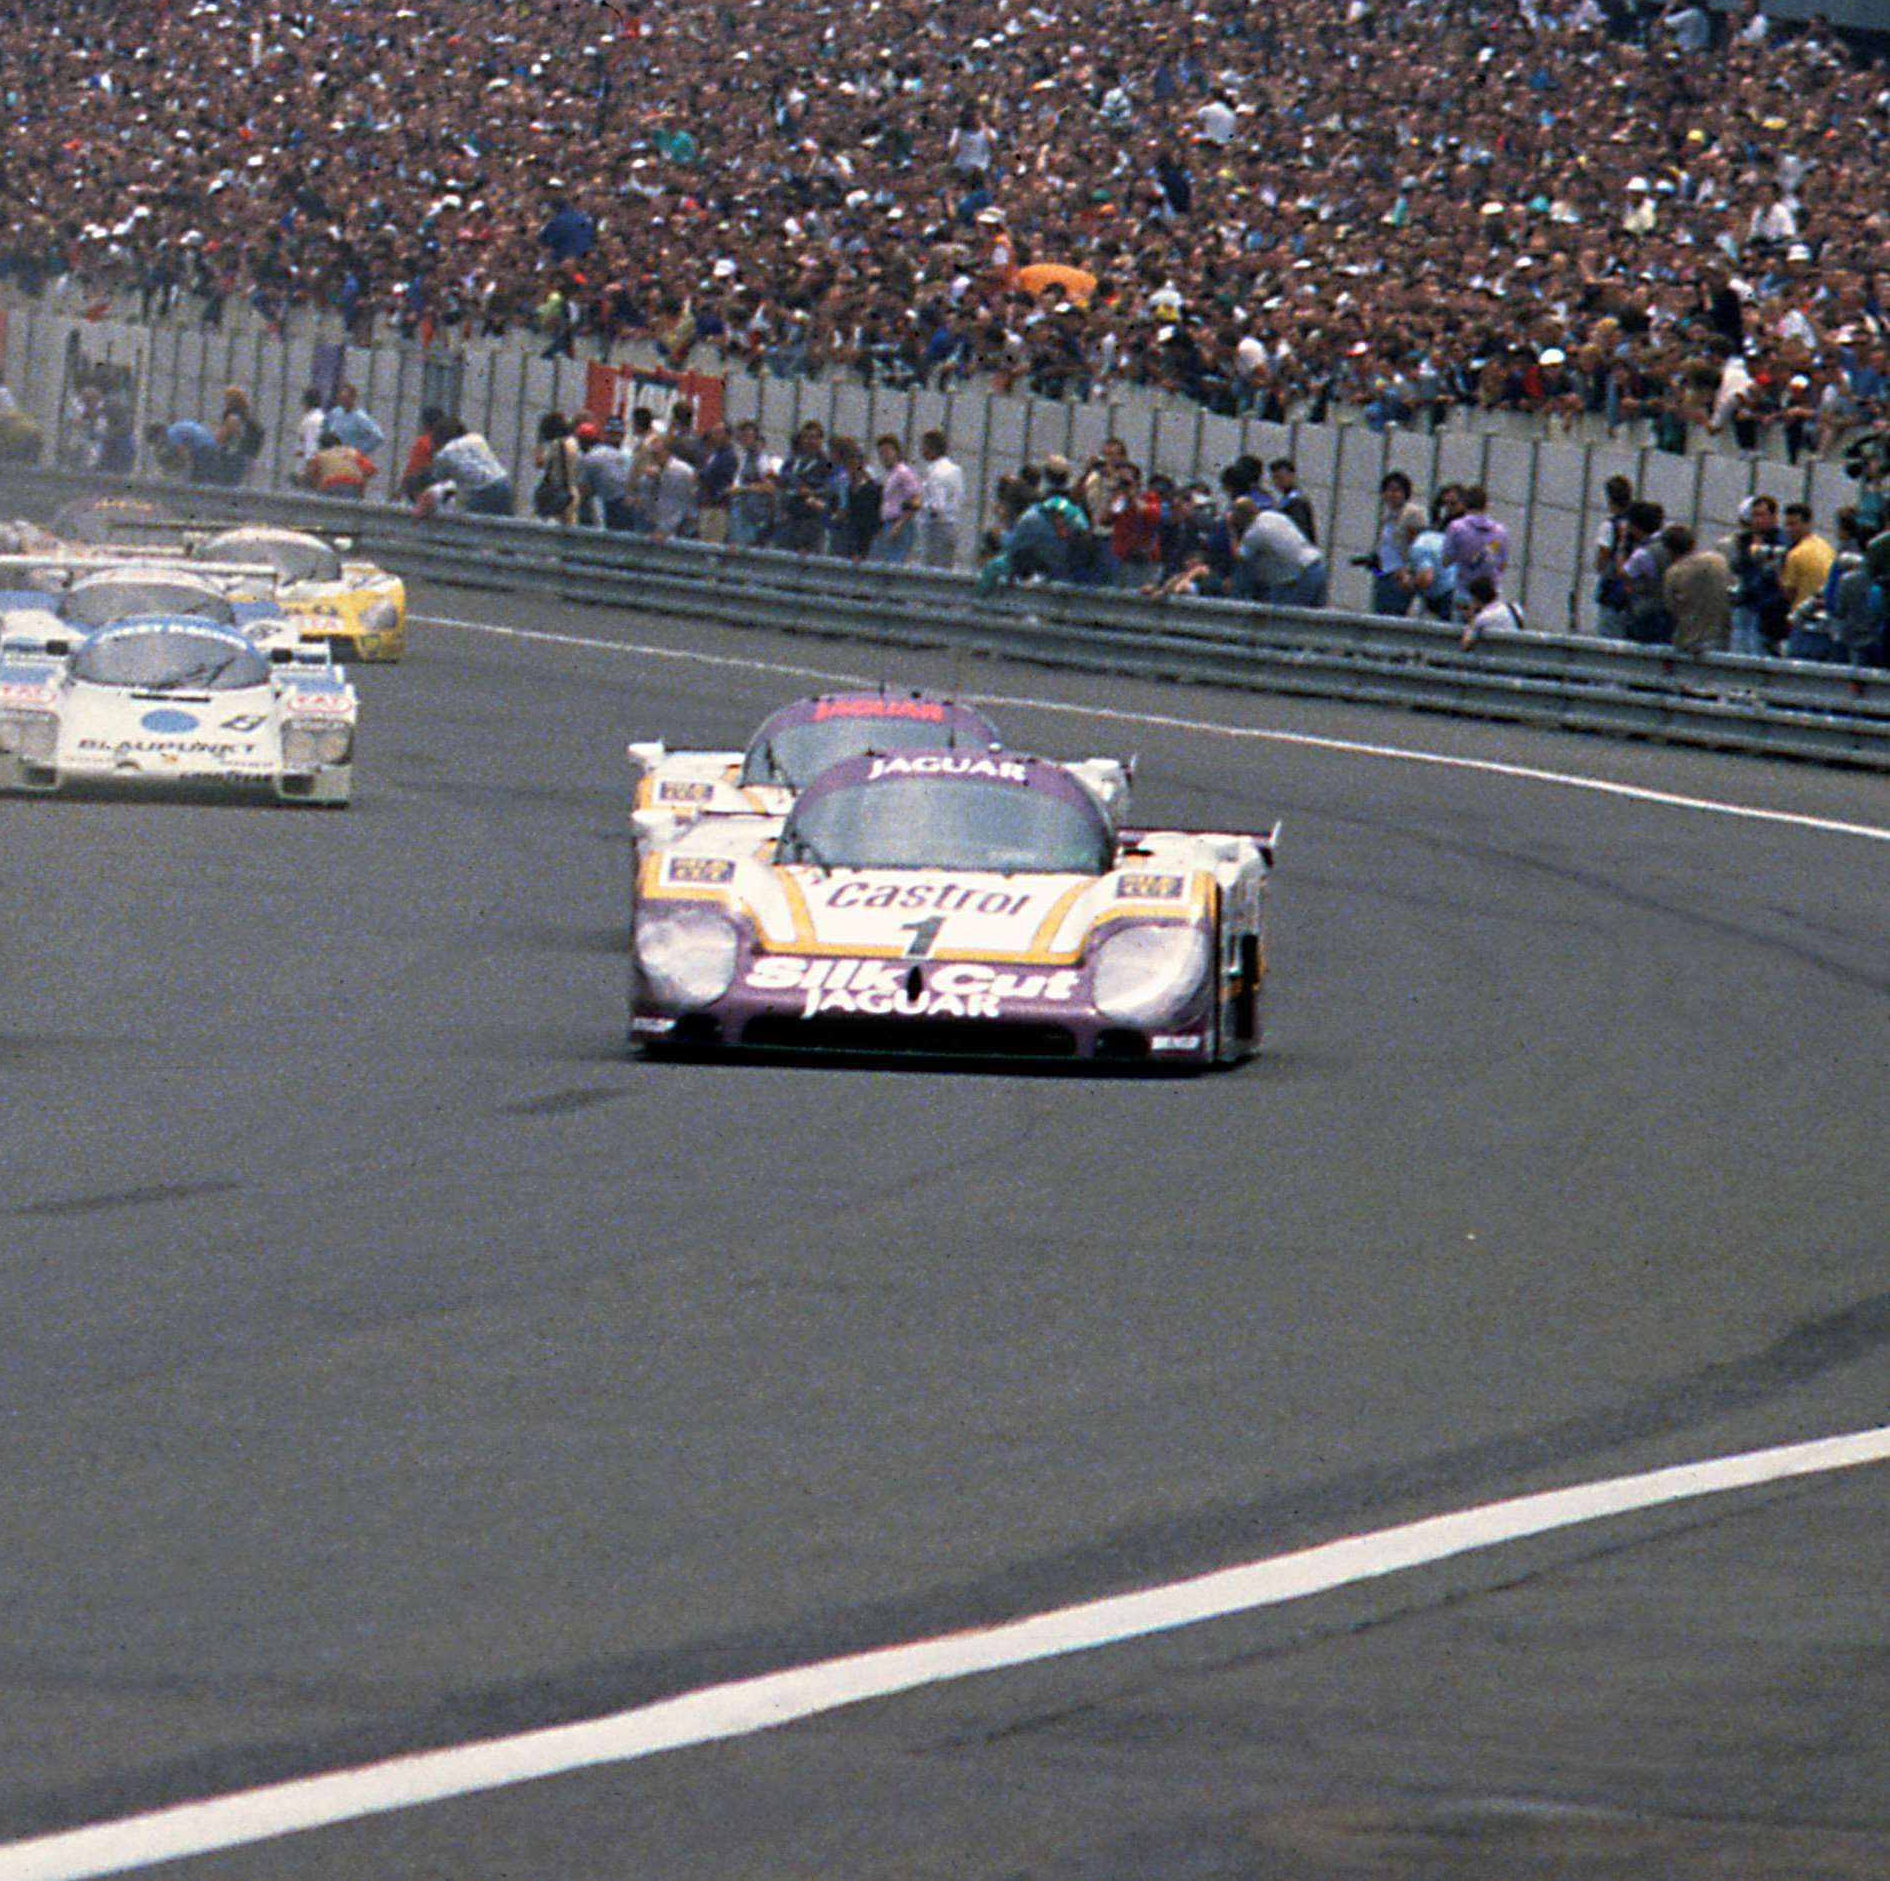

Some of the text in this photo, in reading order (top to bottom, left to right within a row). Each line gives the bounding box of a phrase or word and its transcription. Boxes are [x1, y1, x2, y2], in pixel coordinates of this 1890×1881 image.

[812, 699, 945, 724] JAGUAR
[77, 738, 257, 755] BLAUPUNKT
[867, 756, 1028, 782] JAGUAR
[825, 881, 1035, 917] Castrol
[900, 915, 948, 959] 1
[744, 955, 1080, 1000] Silk Cut
[800, 987, 1001, 1020] JAGUAR
